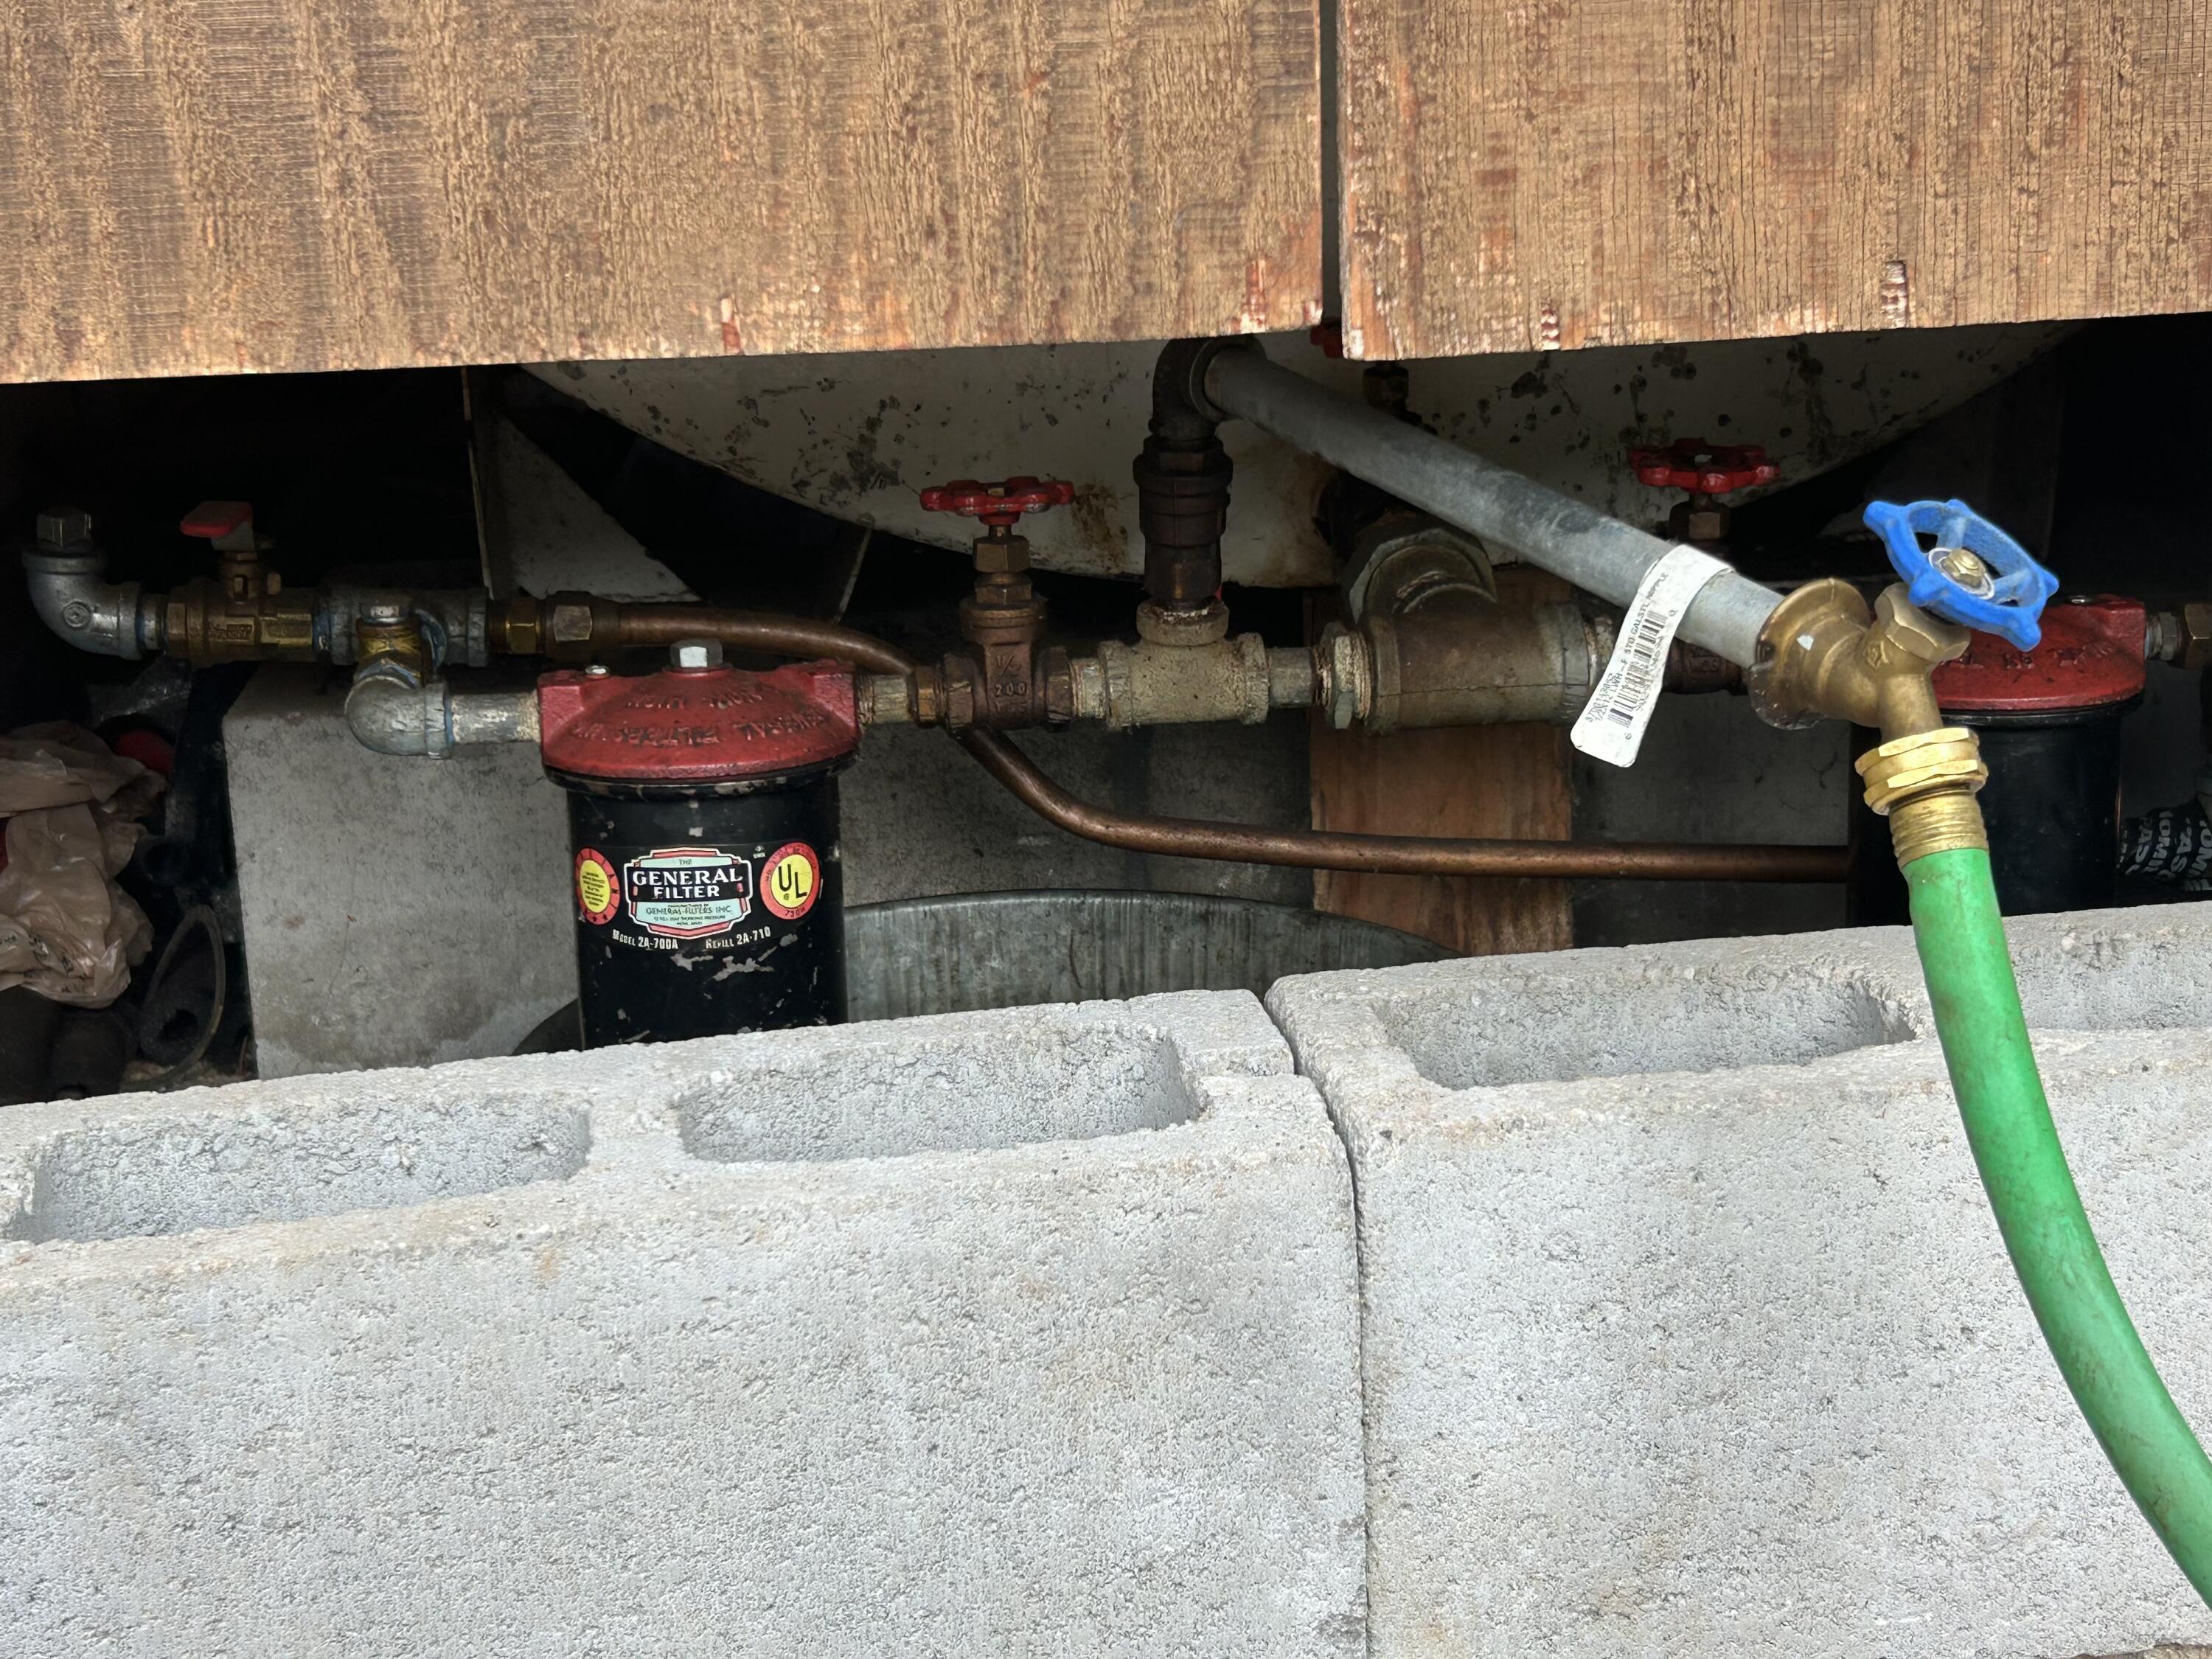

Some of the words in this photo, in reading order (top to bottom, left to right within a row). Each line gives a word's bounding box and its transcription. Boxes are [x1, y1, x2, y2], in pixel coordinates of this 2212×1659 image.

[994, 682, 1028, 697] 200
[632, 868, 744, 886] GENERAL
[778, 863, 807, 899] UL
[653, 885, 720, 900] FILTER
[612, 929, 636, 947] MODEL
